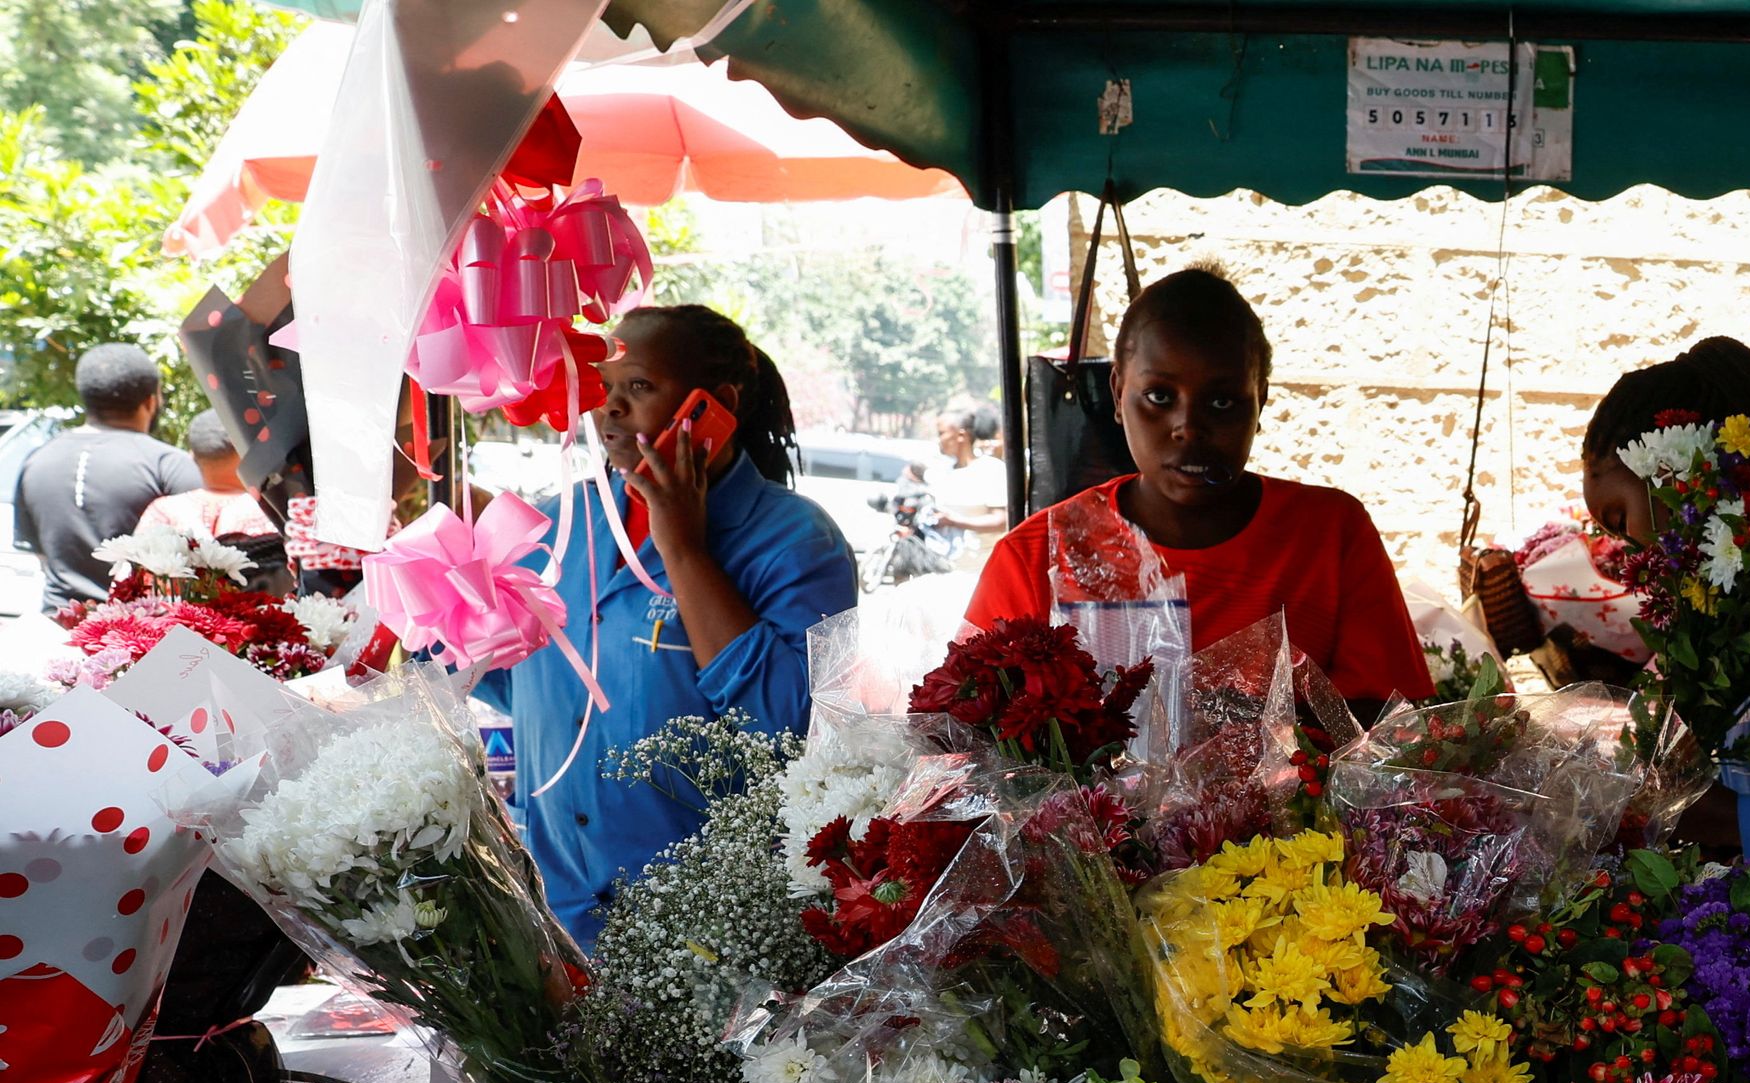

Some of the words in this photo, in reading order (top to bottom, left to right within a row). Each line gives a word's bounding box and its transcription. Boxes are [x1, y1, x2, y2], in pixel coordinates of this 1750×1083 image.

[1367, 56, 1410, 71] LIPA
[1416, 58, 1443, 73] NA
[1367, 87, 1391, 97] BUY
[1394, 88, 1436, 98] GOODS
[1439, 89, 1463, 99] TILL
[1405, 147, 1428, 157] ANN
